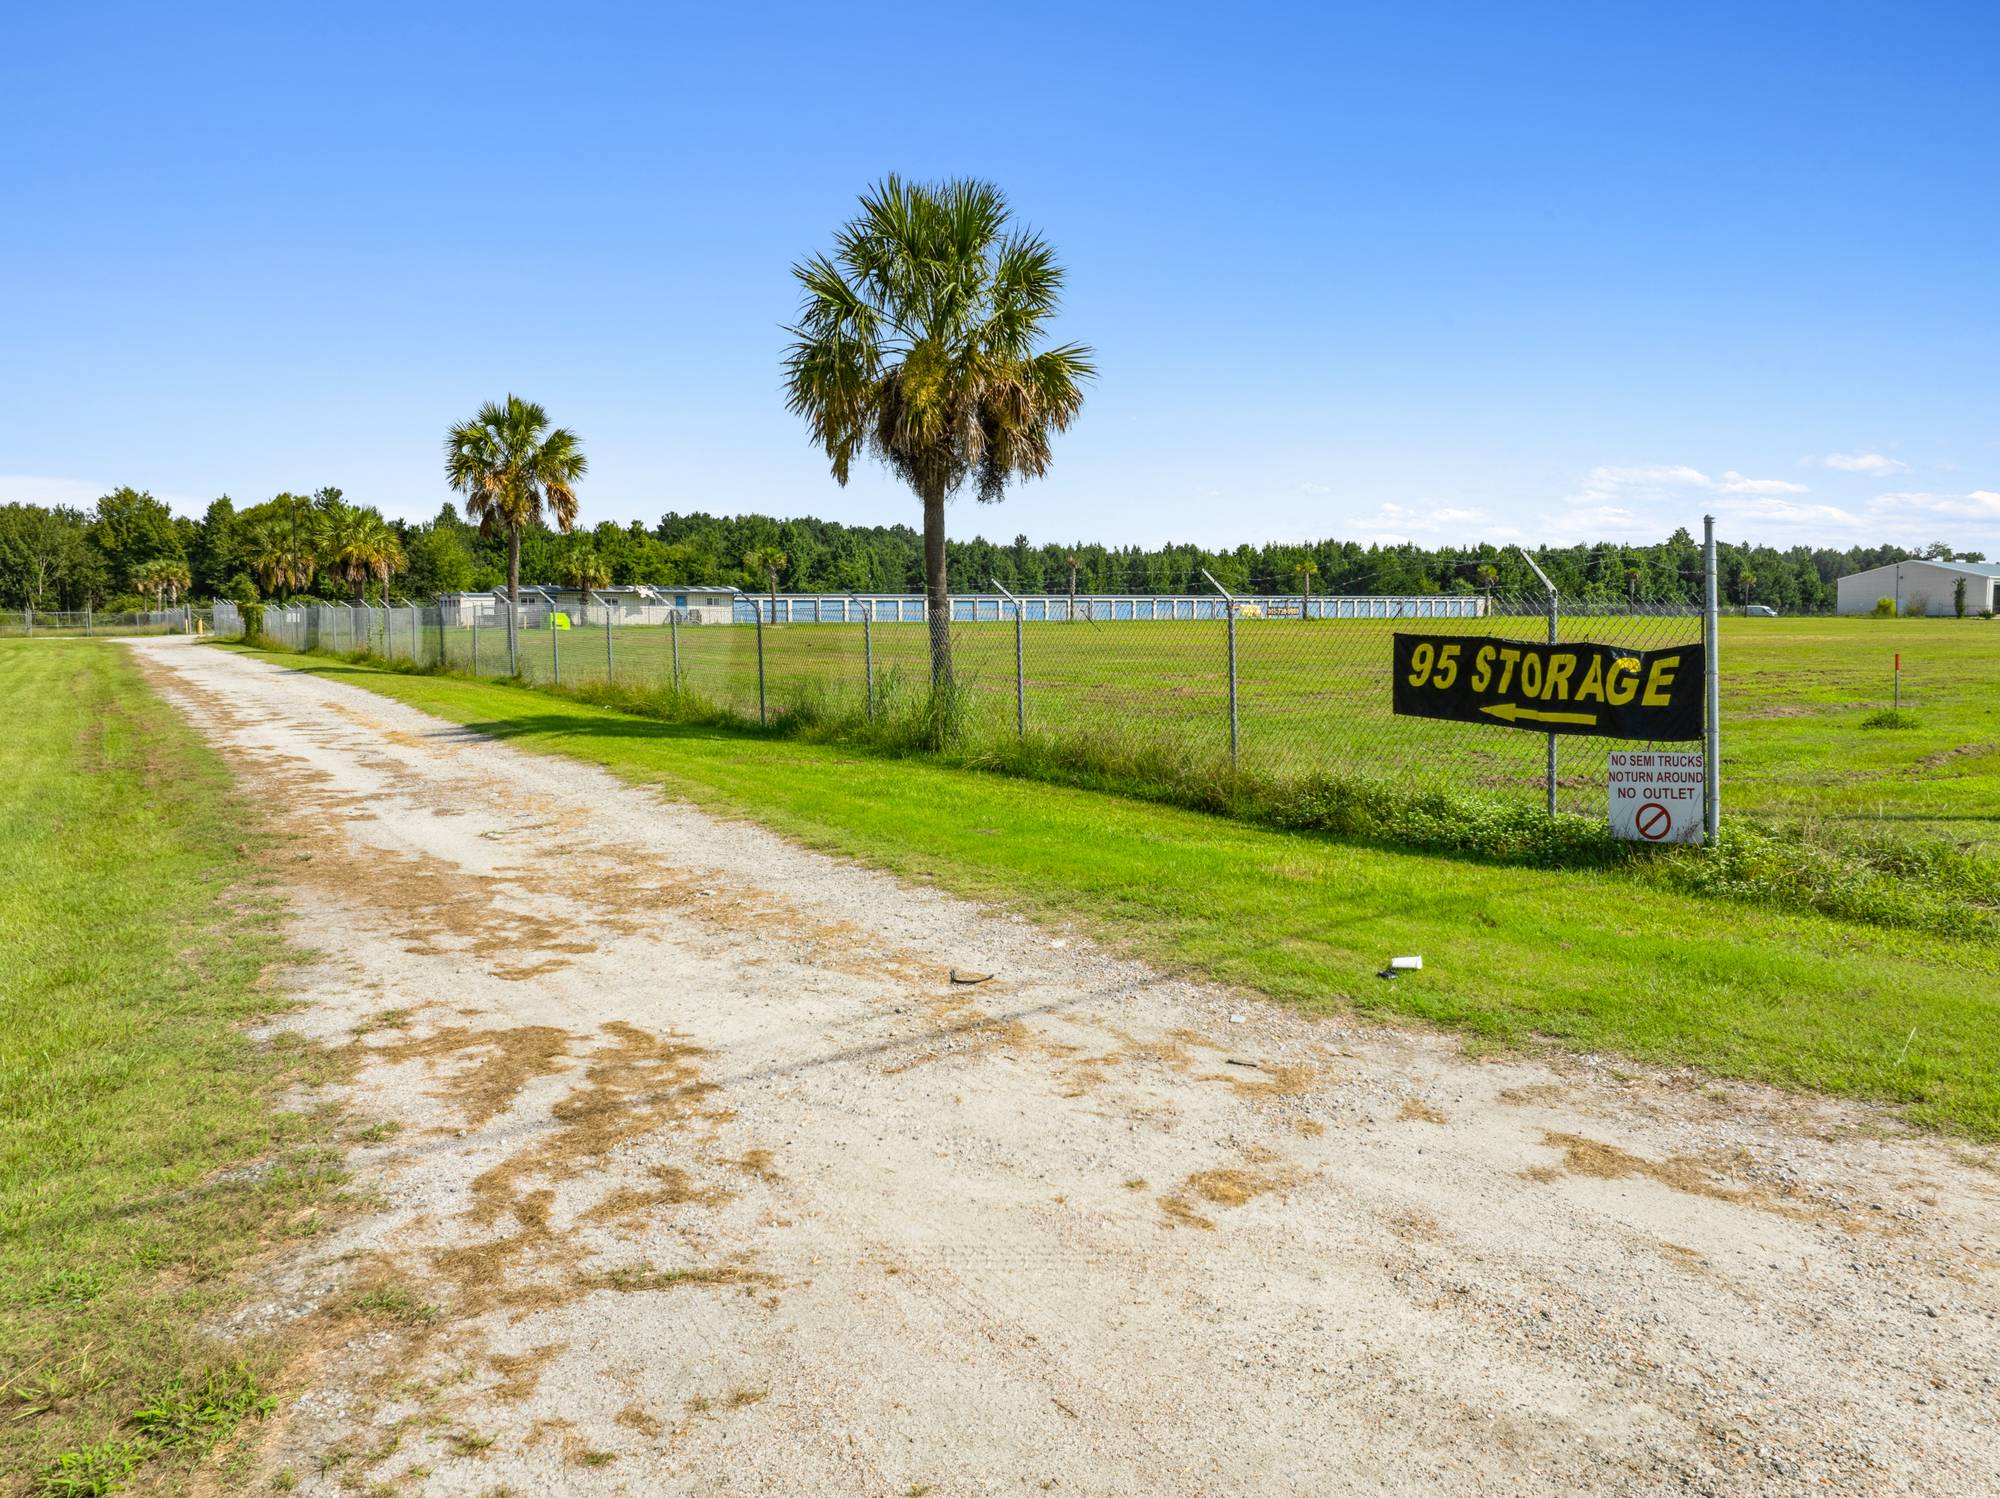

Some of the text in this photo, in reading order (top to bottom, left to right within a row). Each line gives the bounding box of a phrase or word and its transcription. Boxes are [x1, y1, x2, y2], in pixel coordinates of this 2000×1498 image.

[1408, 643, 1681, 706] 95 STORAGE
[1611, 754, 1703, 768] NO SEMI TRUCKS
[1656, 771, 1704, 783] AROUND
[1617, 787, 1695, 800] NO OUTLET
